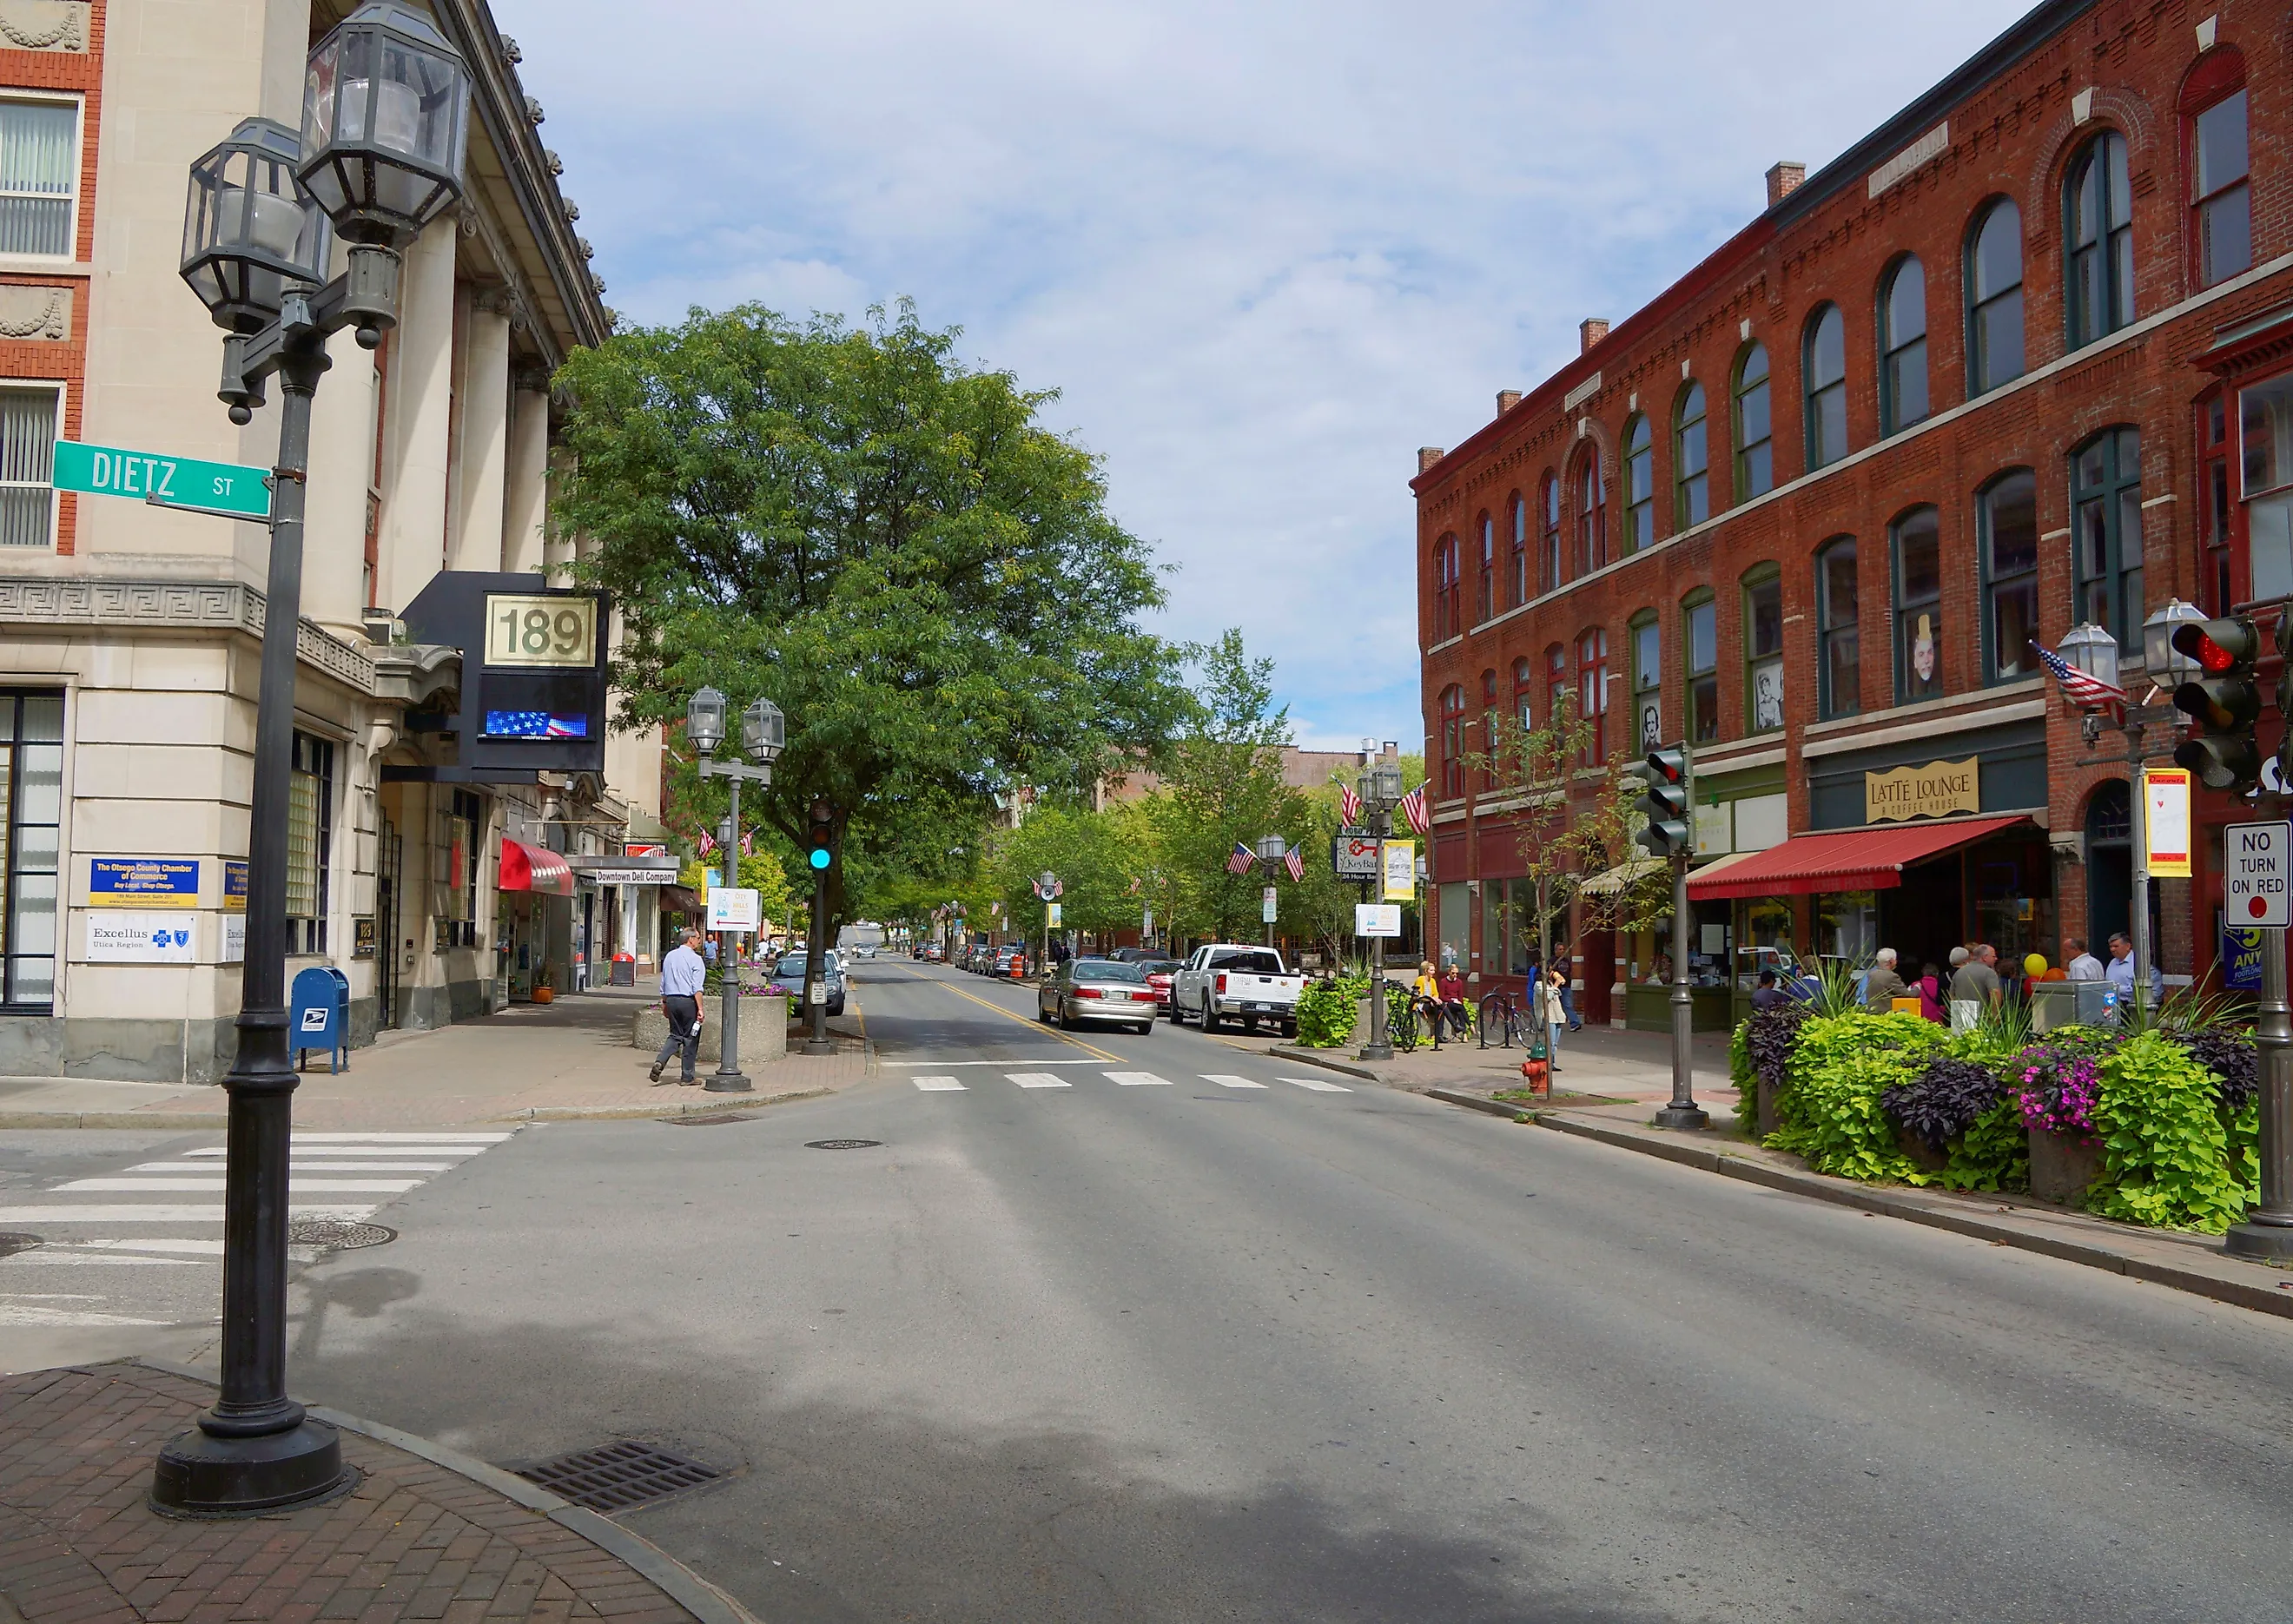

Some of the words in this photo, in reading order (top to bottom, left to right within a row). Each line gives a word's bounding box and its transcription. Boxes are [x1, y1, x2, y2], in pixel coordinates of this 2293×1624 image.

[92, 452, 177, 497] DIETZ
[212, 477, 234, 496] ST
[500, 609, 582, 655] 189
[1917, 775, 1970, 799] LOUNGE
[1881, 807, 1886, 815] A
[1892, 802, 1923, 815] COFFEE
[1929, 798, 1958, 810] HOUSE
[2243, 832, 2271, 852] NO
[111, 863, 135, 872] Otsego
[136, 864, 160, 873] County
[2240, 857, 2276, 873] TURN
[598, 872, 631, 881] Downtown
[631, 871, 644, 881] Deli
[645, 872, 675, 884] Company
[1845, 875, 1874, 889] HOUSE
[2232, 880, 2250, 894] ON
[2257, 878, 2284, 893] RED
[94, 928, 148, 938] Excellus
[2233, 951, 2261, 969] ANY
